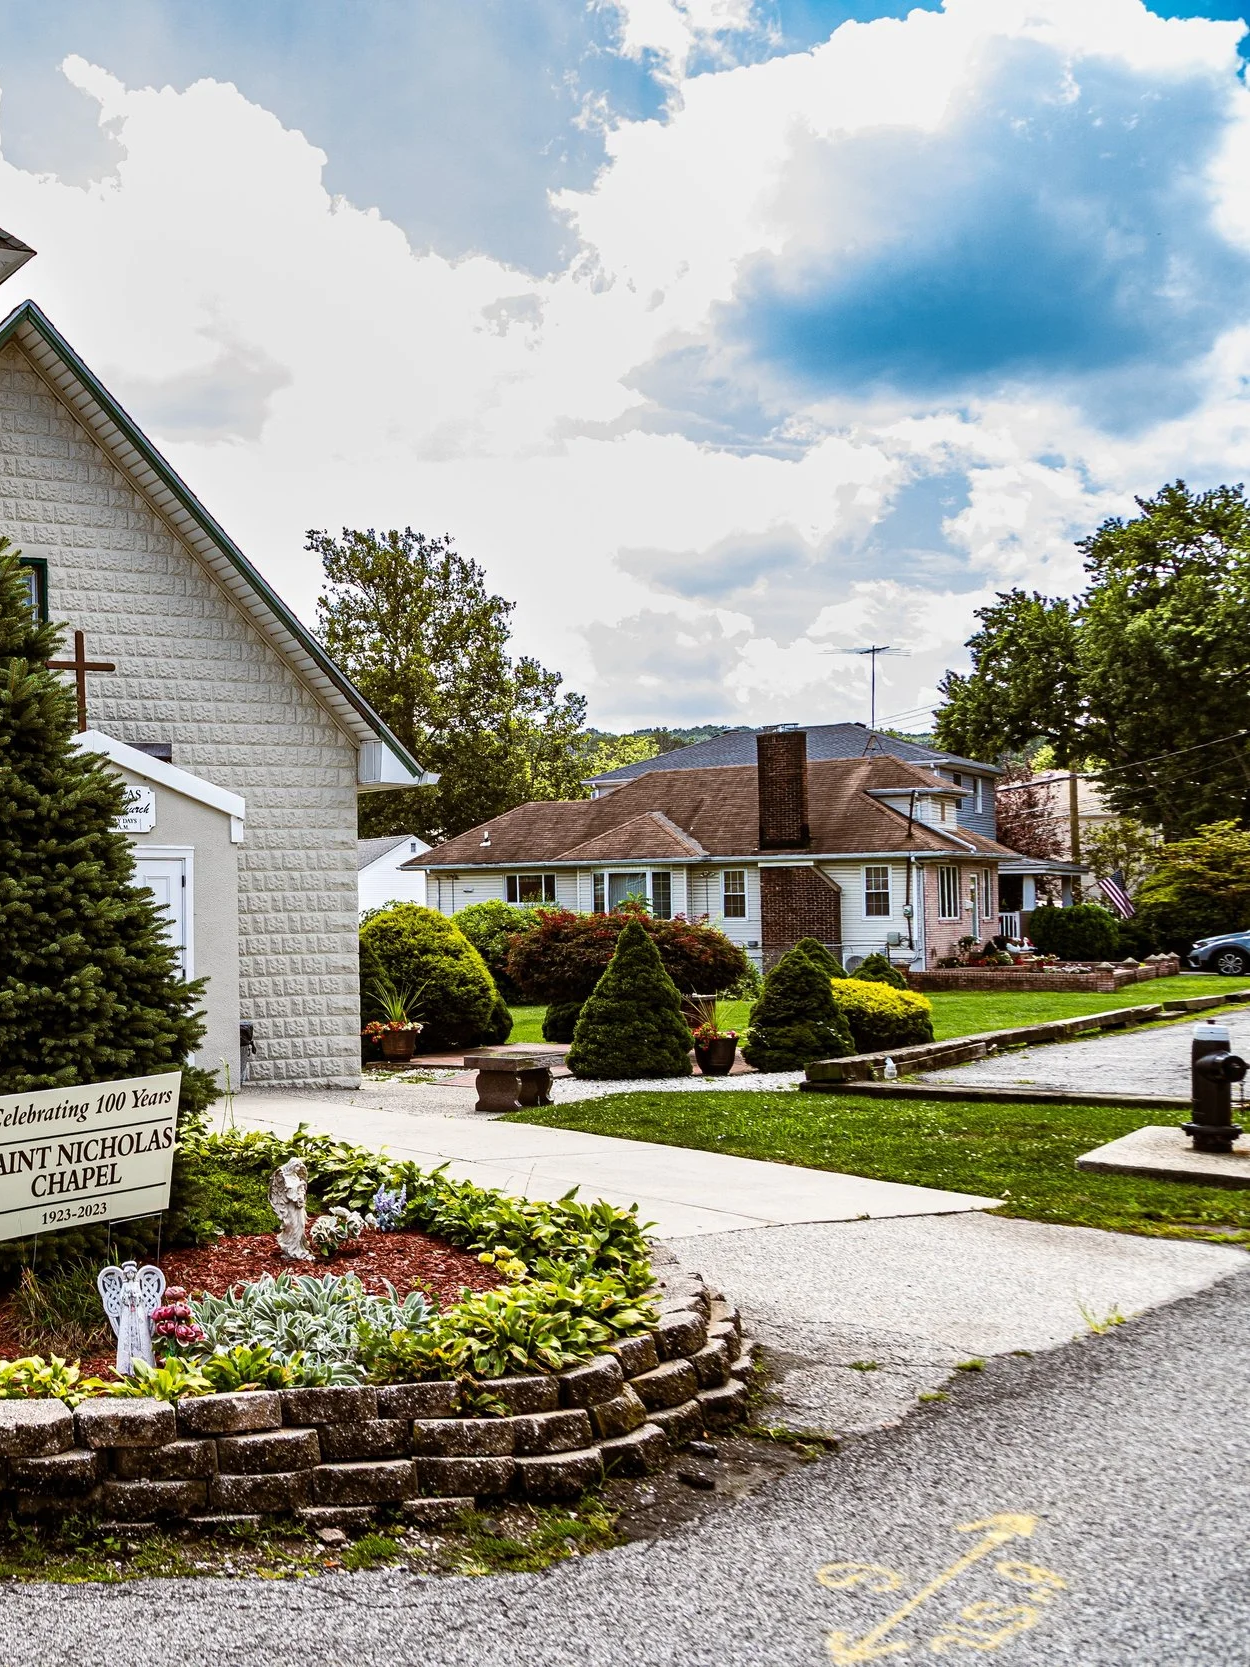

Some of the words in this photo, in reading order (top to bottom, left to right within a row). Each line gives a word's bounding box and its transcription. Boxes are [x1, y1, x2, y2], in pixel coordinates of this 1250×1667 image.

[94, 1091, 126, 1114] 100
[131, 1089, 172, 1109] Years
[56, 1126, 173, 1167] NICHOLAS
[31, 1163, 123, 1198] CHAPEL
[42, 1202, 107, 1225] 1923-2023
